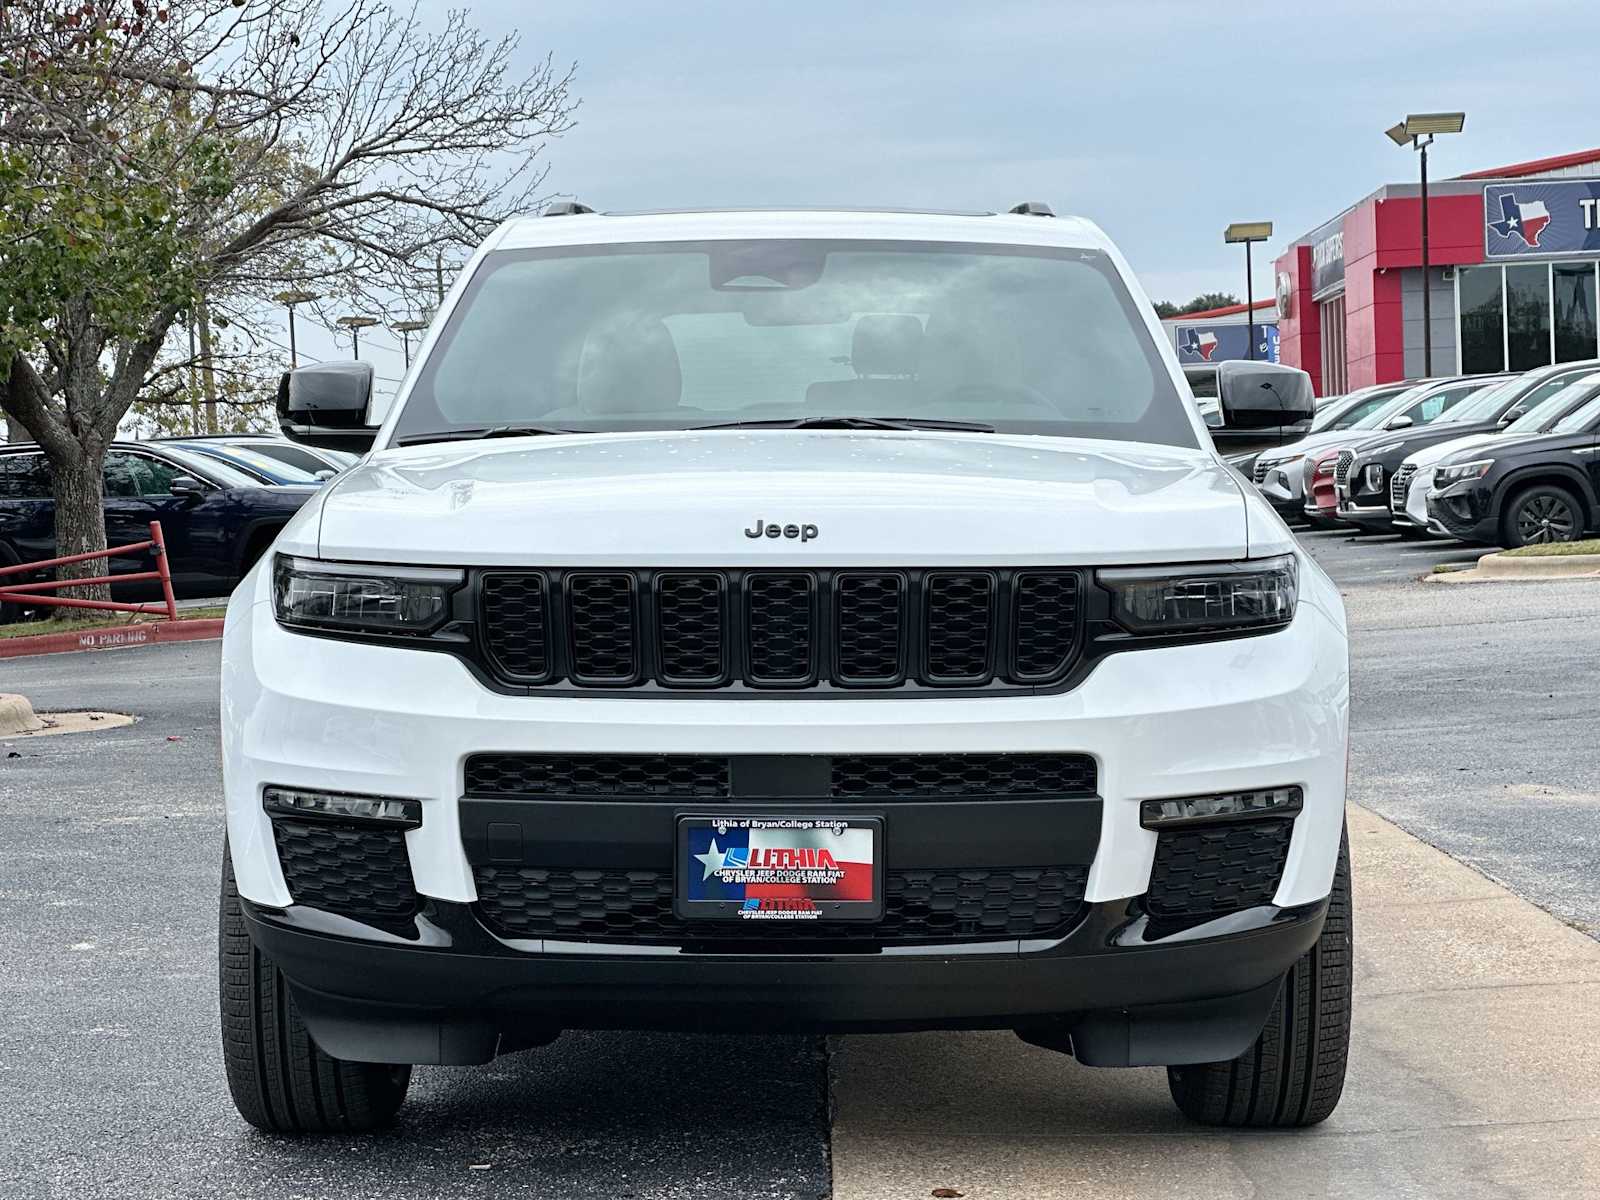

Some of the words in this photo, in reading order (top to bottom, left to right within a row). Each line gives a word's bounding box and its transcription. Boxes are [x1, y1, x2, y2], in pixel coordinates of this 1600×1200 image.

[744, 519, 819, 542] Jeep
[80, 634, 95, 645] NO
[712, 820, 738, 828] Lithia
[740, 820, 750, 828] of
[752, 820, 813, 829] Bryan/College
[815, 820, 848, 828] Station
[748, 848, 839, 868] LITHIA
[828, 870, 845, 878] FIAT
[802, 876, 836, 884] STATION
